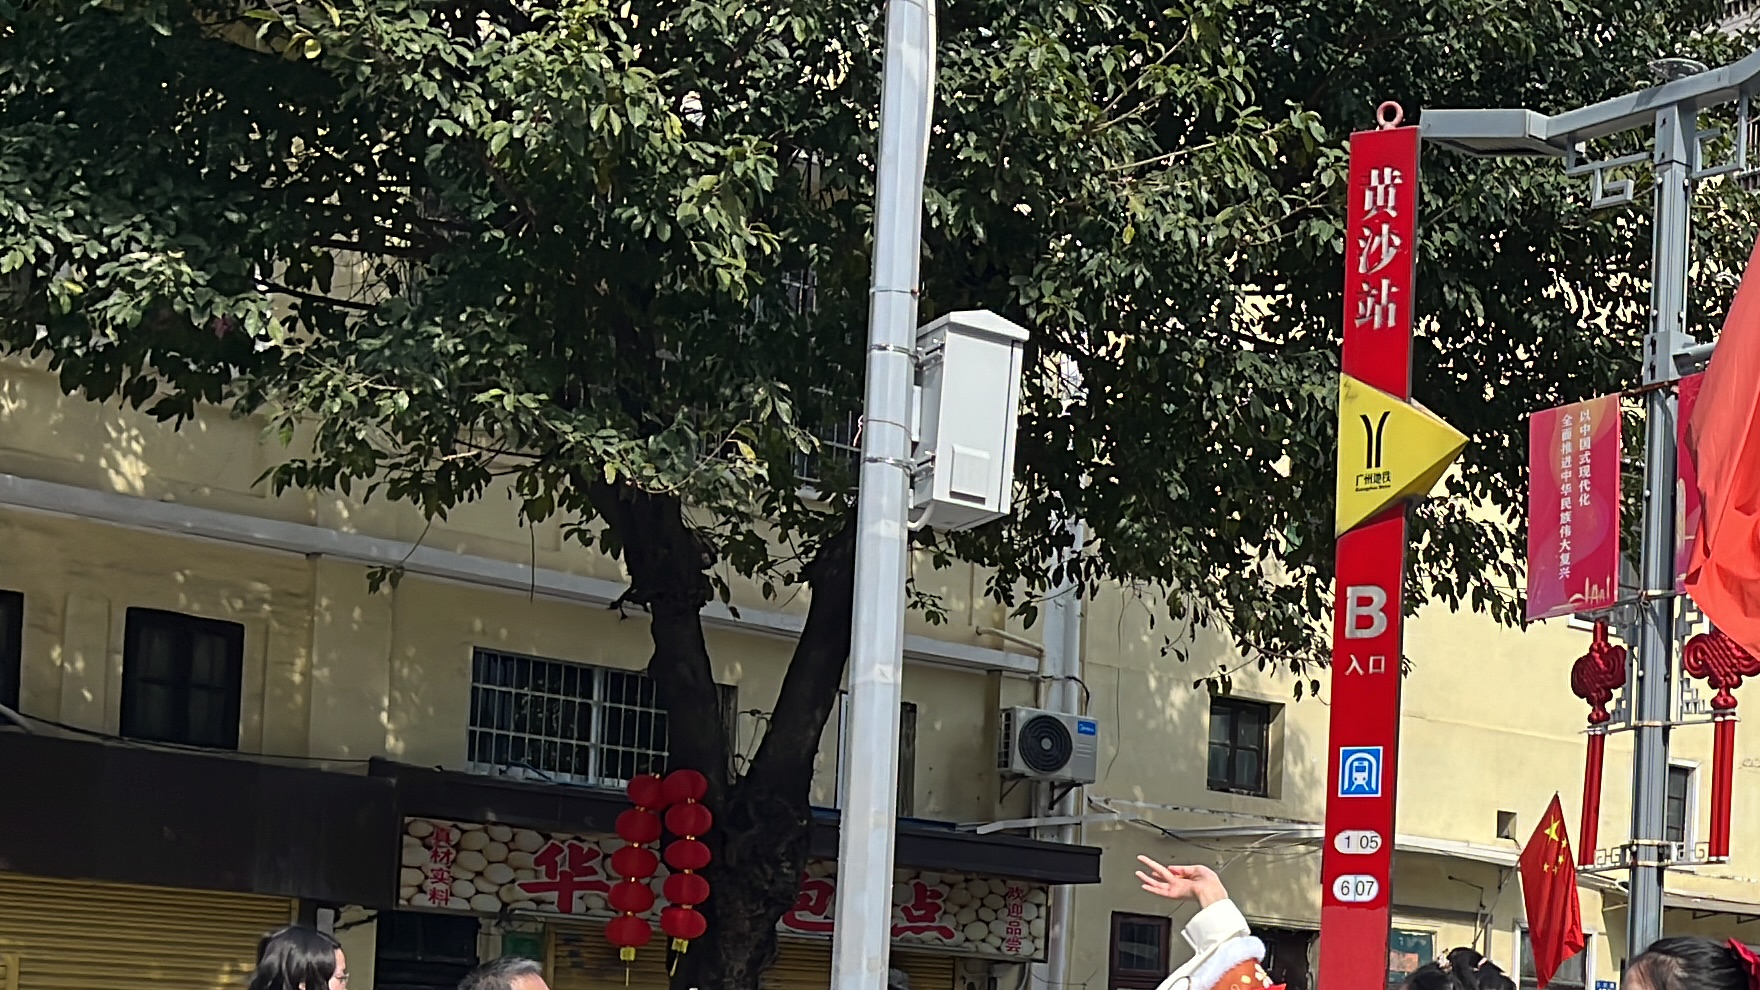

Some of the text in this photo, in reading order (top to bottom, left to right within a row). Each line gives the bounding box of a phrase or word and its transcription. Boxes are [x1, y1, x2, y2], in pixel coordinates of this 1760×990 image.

[1355, 166, 1404, 330] 黄沙站
[1558, 413, 1573, 580] 全面推进中华民族伟大复兴
[1578, 408, 1591, 507] 以中国式现代化
[1344, 584, 1388, 639] B
[1344, 654, 1386, 676] 入口
[428, 826, 453, 907] 真材实料
[1005, 885, 1024, 953] 欢迎品尝
